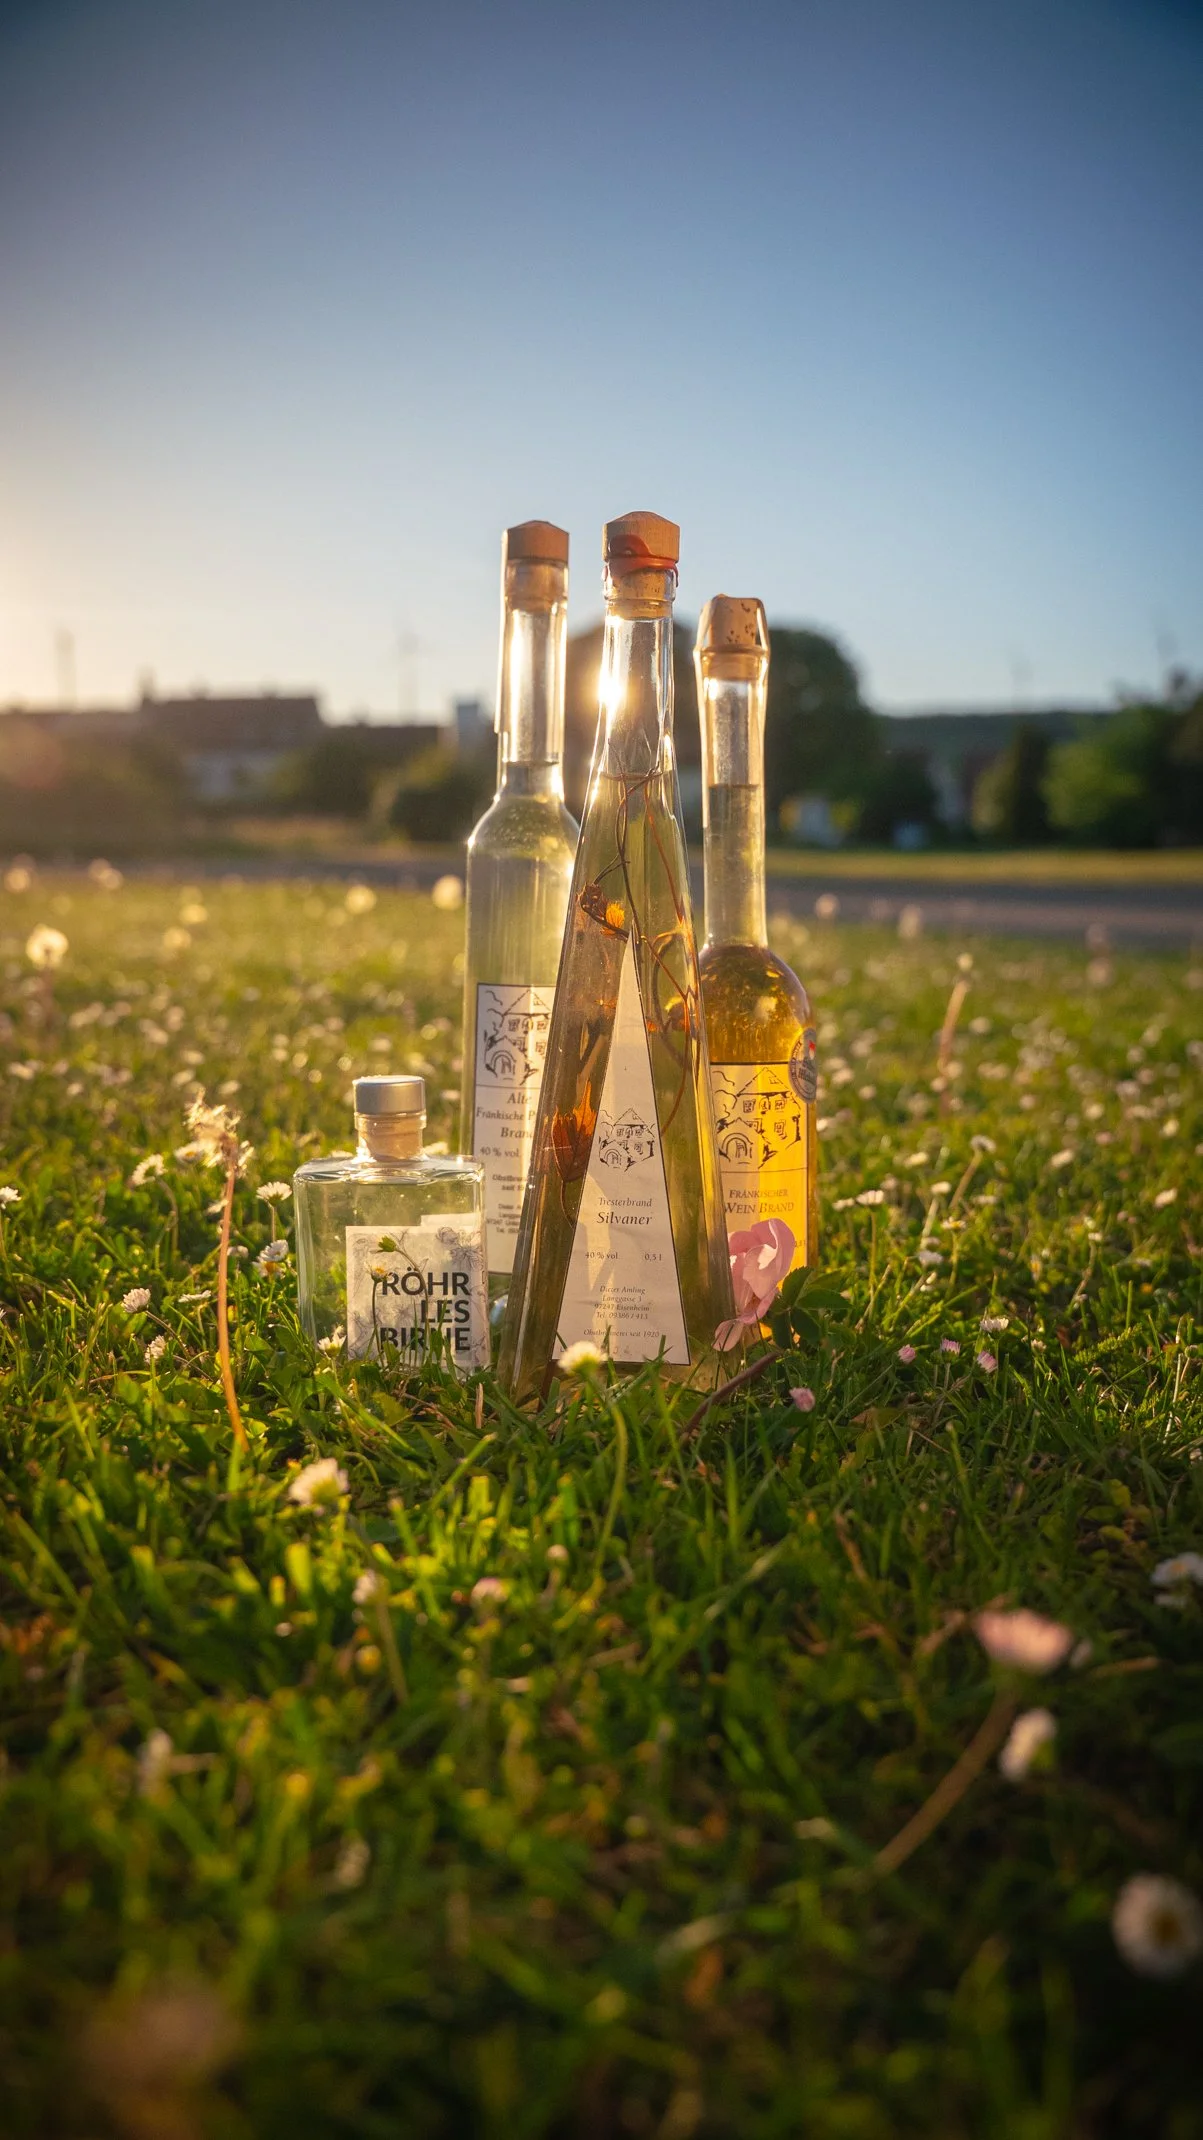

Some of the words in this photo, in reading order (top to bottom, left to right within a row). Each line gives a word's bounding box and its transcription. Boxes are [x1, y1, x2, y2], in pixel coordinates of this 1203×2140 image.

[599, 1197, 653, 1207] Tresterbrand
[596, 1211, 653, 1225] Silvaner
[585, 1251, 595, 1260] 40
[644, 1253, 657, 1262] 0,5
[381, 1266, 472, 1296] RÖHR
[420, 1299, 471, 1324] LES
